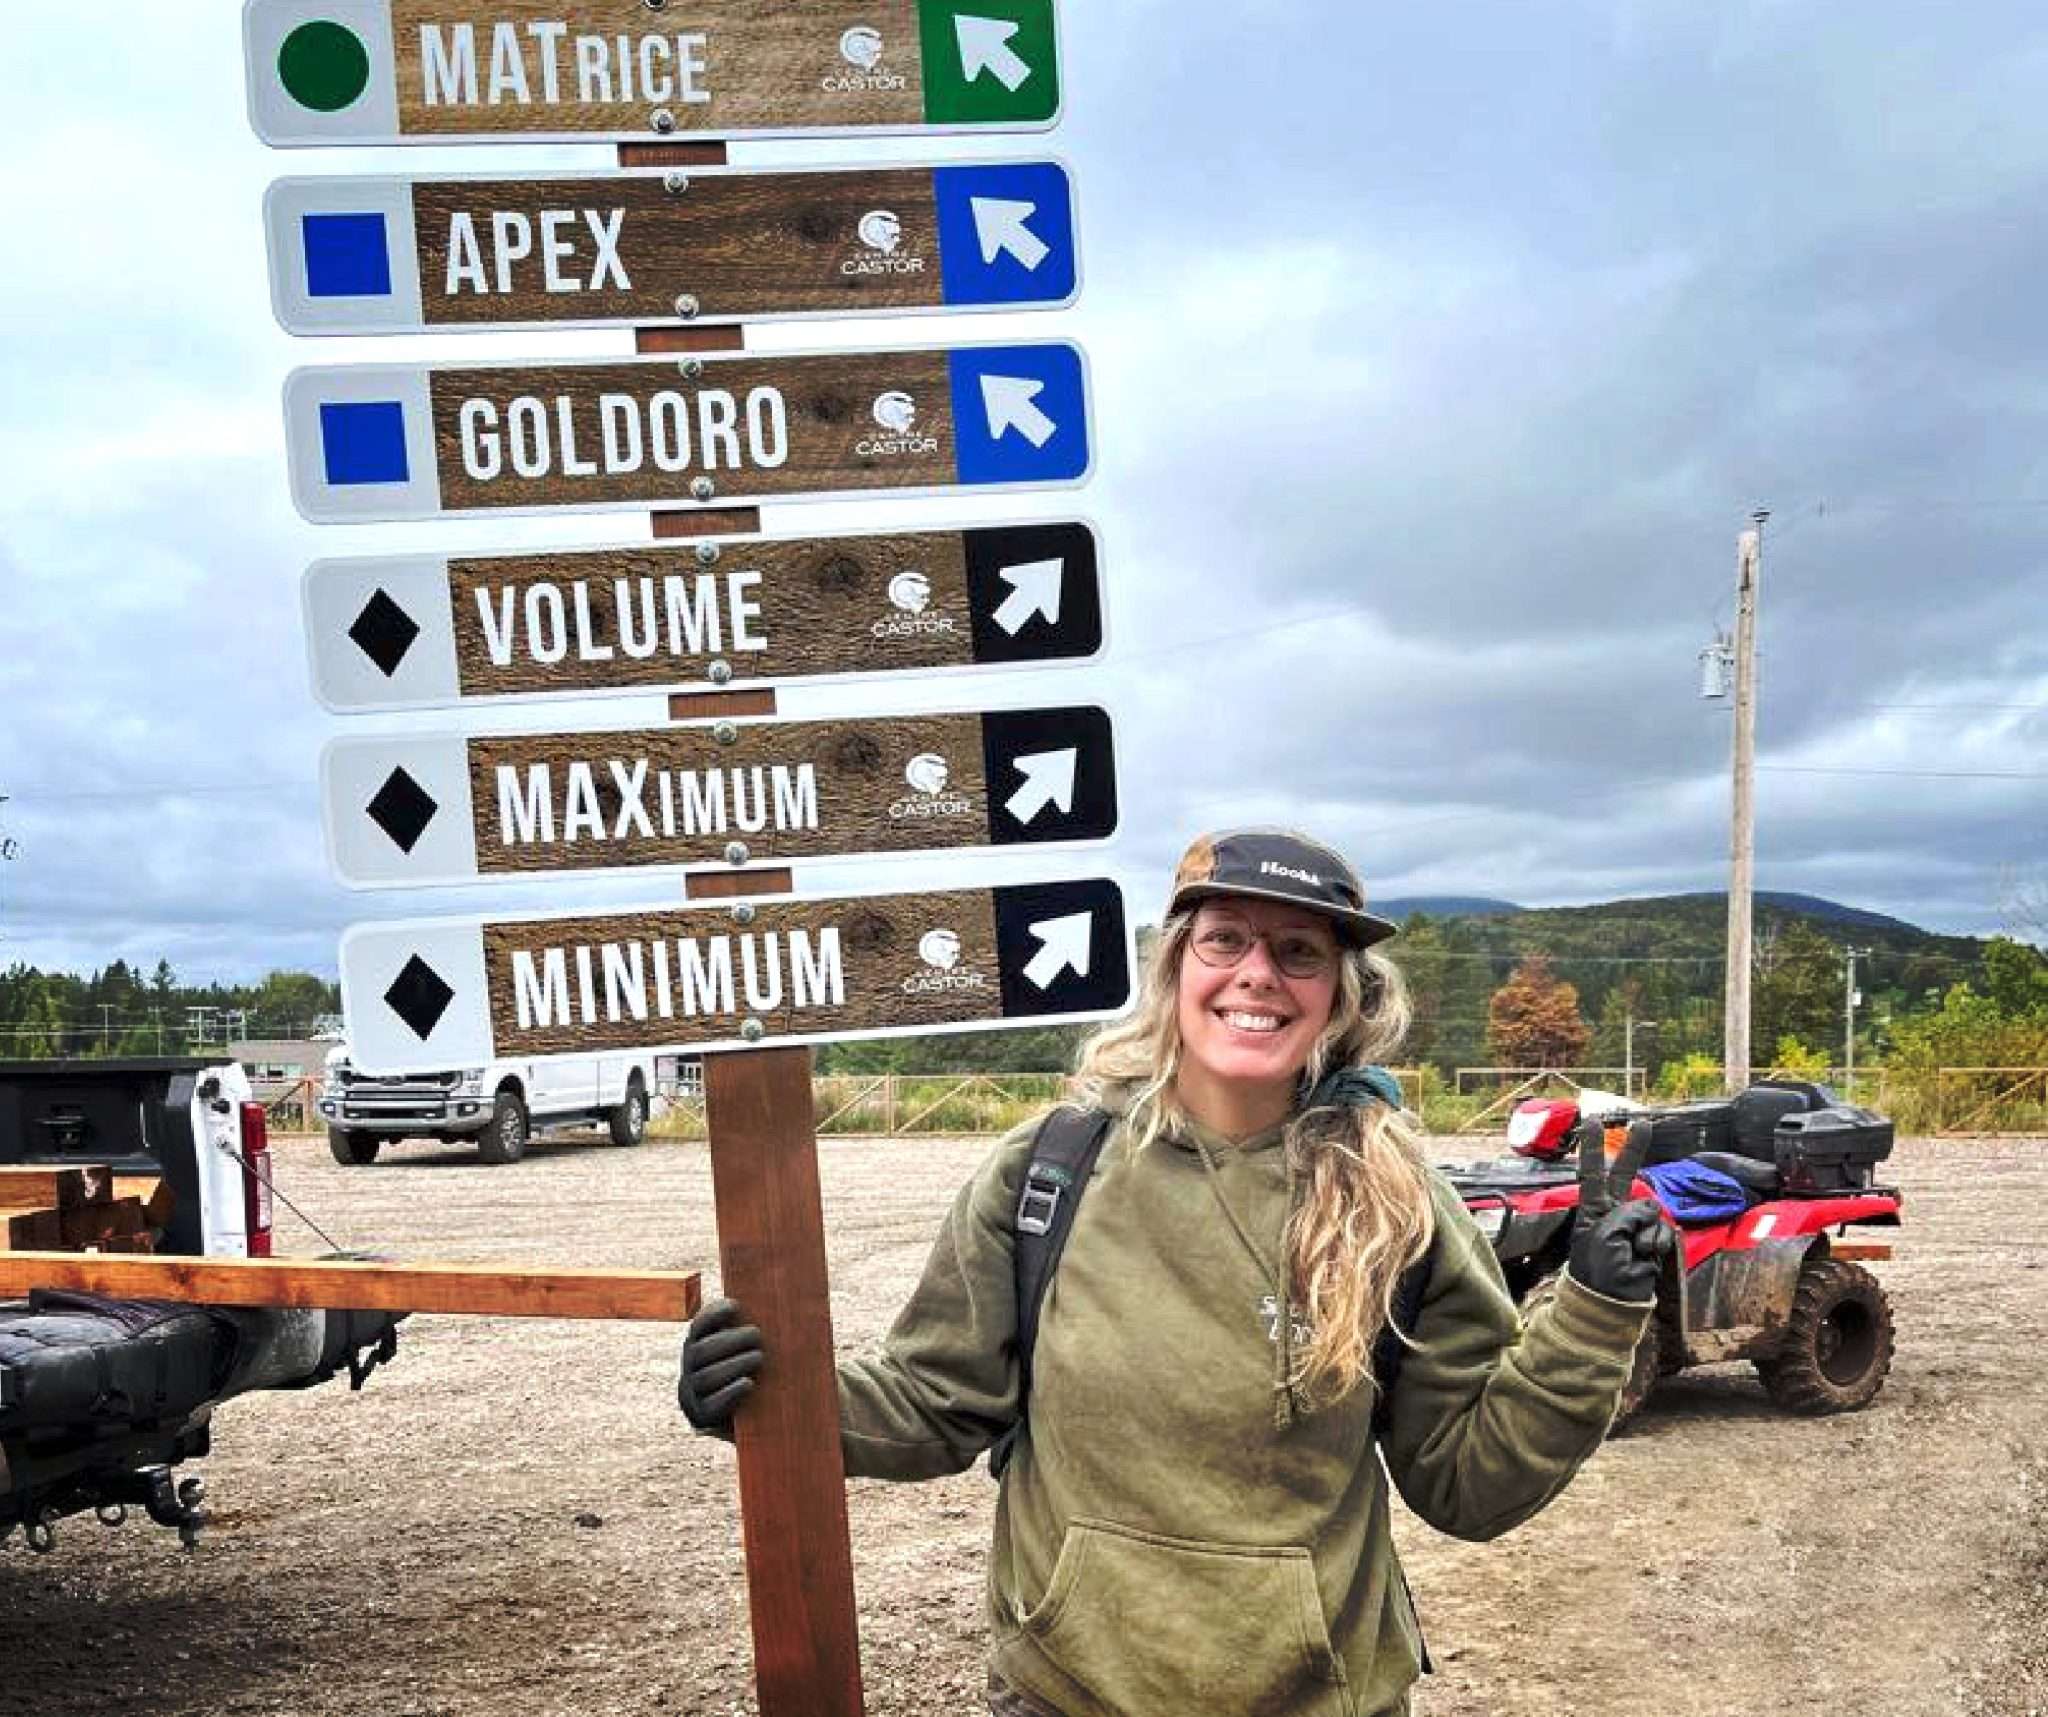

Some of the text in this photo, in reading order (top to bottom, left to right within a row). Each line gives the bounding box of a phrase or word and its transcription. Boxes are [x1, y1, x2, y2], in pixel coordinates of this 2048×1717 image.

[420, 22, 712, 105] MATRICE
[821, 75, 905, 92] CASTOR
[446, 208, 632, 295] APEX
[841, 258, 925, 275] CASTOR
[459, 386, 788, 481] GOLDORO
[855, 438, 938, 455] CASTOR
[474, 571, 768, 666] VOLUME
[871, 619, 955, 637] CASTOR
[495, 758, 819, 846] MAXIMUM
[888, 801, 970, 818] CASTOR
[512, 928, 845, 1031] MINIMUM
[902, 974, 985, 993] CASTOR
